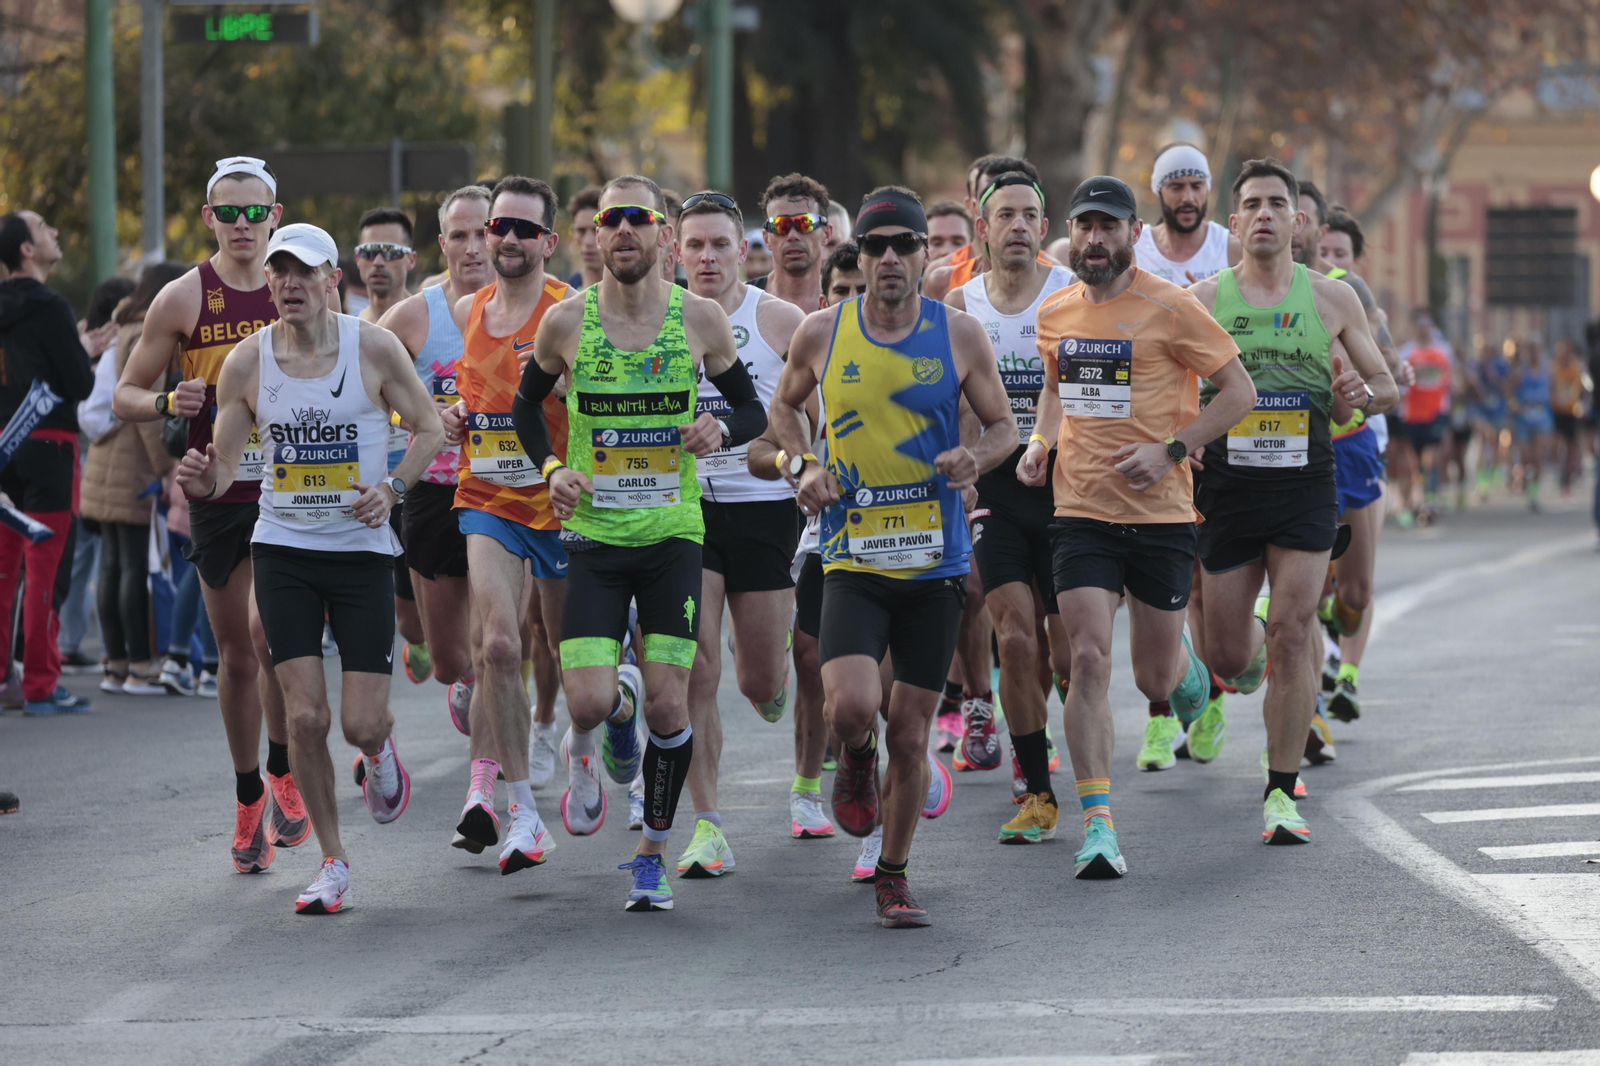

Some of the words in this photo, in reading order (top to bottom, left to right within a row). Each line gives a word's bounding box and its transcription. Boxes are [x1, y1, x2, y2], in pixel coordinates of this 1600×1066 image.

[205, 13, 274, 40] LIBRE
[200, 319, 277, 344] BELGR
[1079, 343, 1121, 354] ZURICH
[1250, 349, 1279, 361] WITH
[1079, 367, 1103, 379] 2572
[1081, 387, 1100, 396] ALBA
[590, 401, 612, 412] RUN
[617, 400, 647, 413] WITH
[1256, 397, 1300, 406] ZURICH
[291, 407, 331, 423] Valley
[491, 418, 514, 426] ZUR
[1260, 421, 1280, 431] 617
[269, 421, 358, 444] Striders
[622, 432, 671, 443] ZURICH
[499, 441, 517, 451] 632
[1254, 438, 1286, 448] VÍCTOR
[300, 449, 347, 460] ZURICH
[497, 459, 523, 469] VIPER
[626, 458, 648, 469] 755
[304, 475, 326, 486] 613
[618, 478, 656, 487] CARLOS
[291, 494, 341, 504] JONATHAN
[876, 487, 927, 502] ZURICH
[883, 515, 904, 529] 771
[861, 538, 896, 550] JAVIER
[900, 533, 932, 546] PAVÓN
